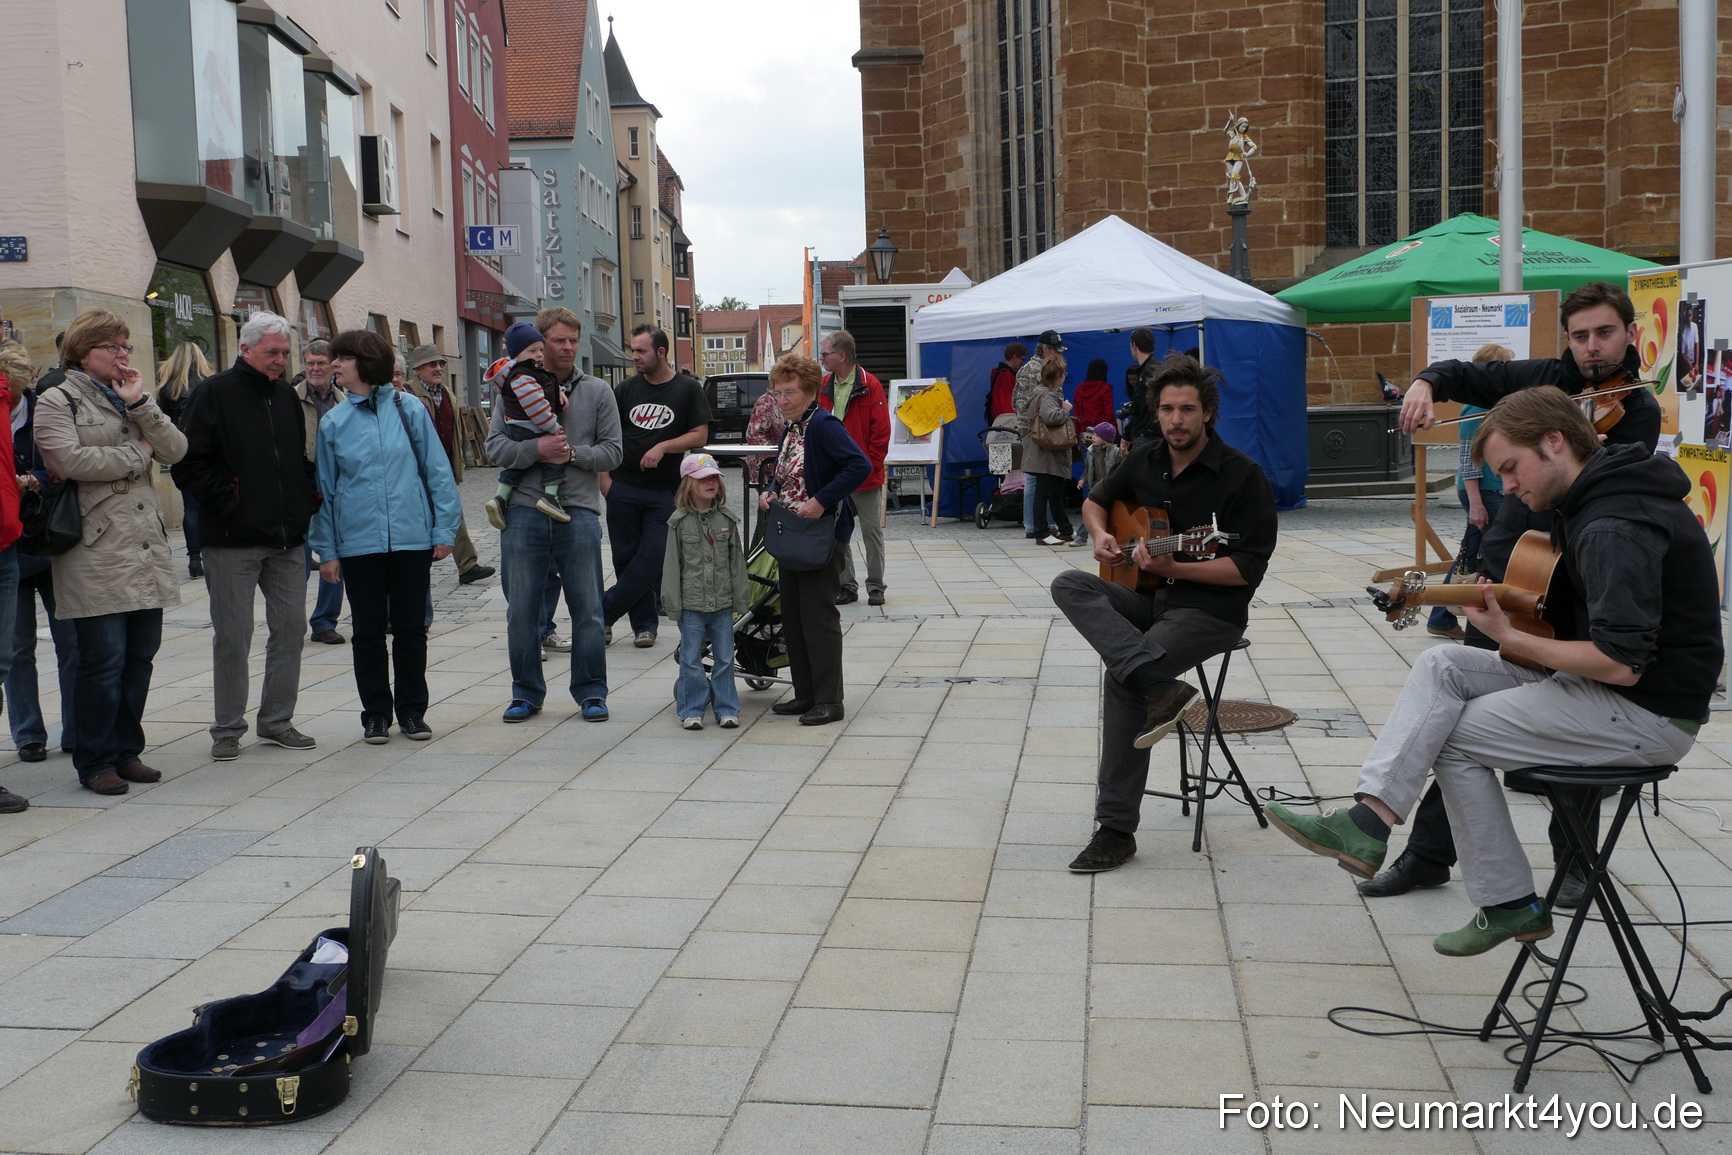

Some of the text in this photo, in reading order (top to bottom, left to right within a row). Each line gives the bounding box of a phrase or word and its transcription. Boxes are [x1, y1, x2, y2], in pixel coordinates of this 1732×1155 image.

[477, 230, 486, 246] C
[500, 230, 511, 246] M
[543, 168, 565, 299] satzke
[1633, 275, 1678, 292] SYMPATHIEBLUME
[1454, 305, 1478, 314] Sozialraum
[1481, 303, 1503, 313] Neumarkt
[1679, 446, 1727, 463] SYMPATHIEBLUME
